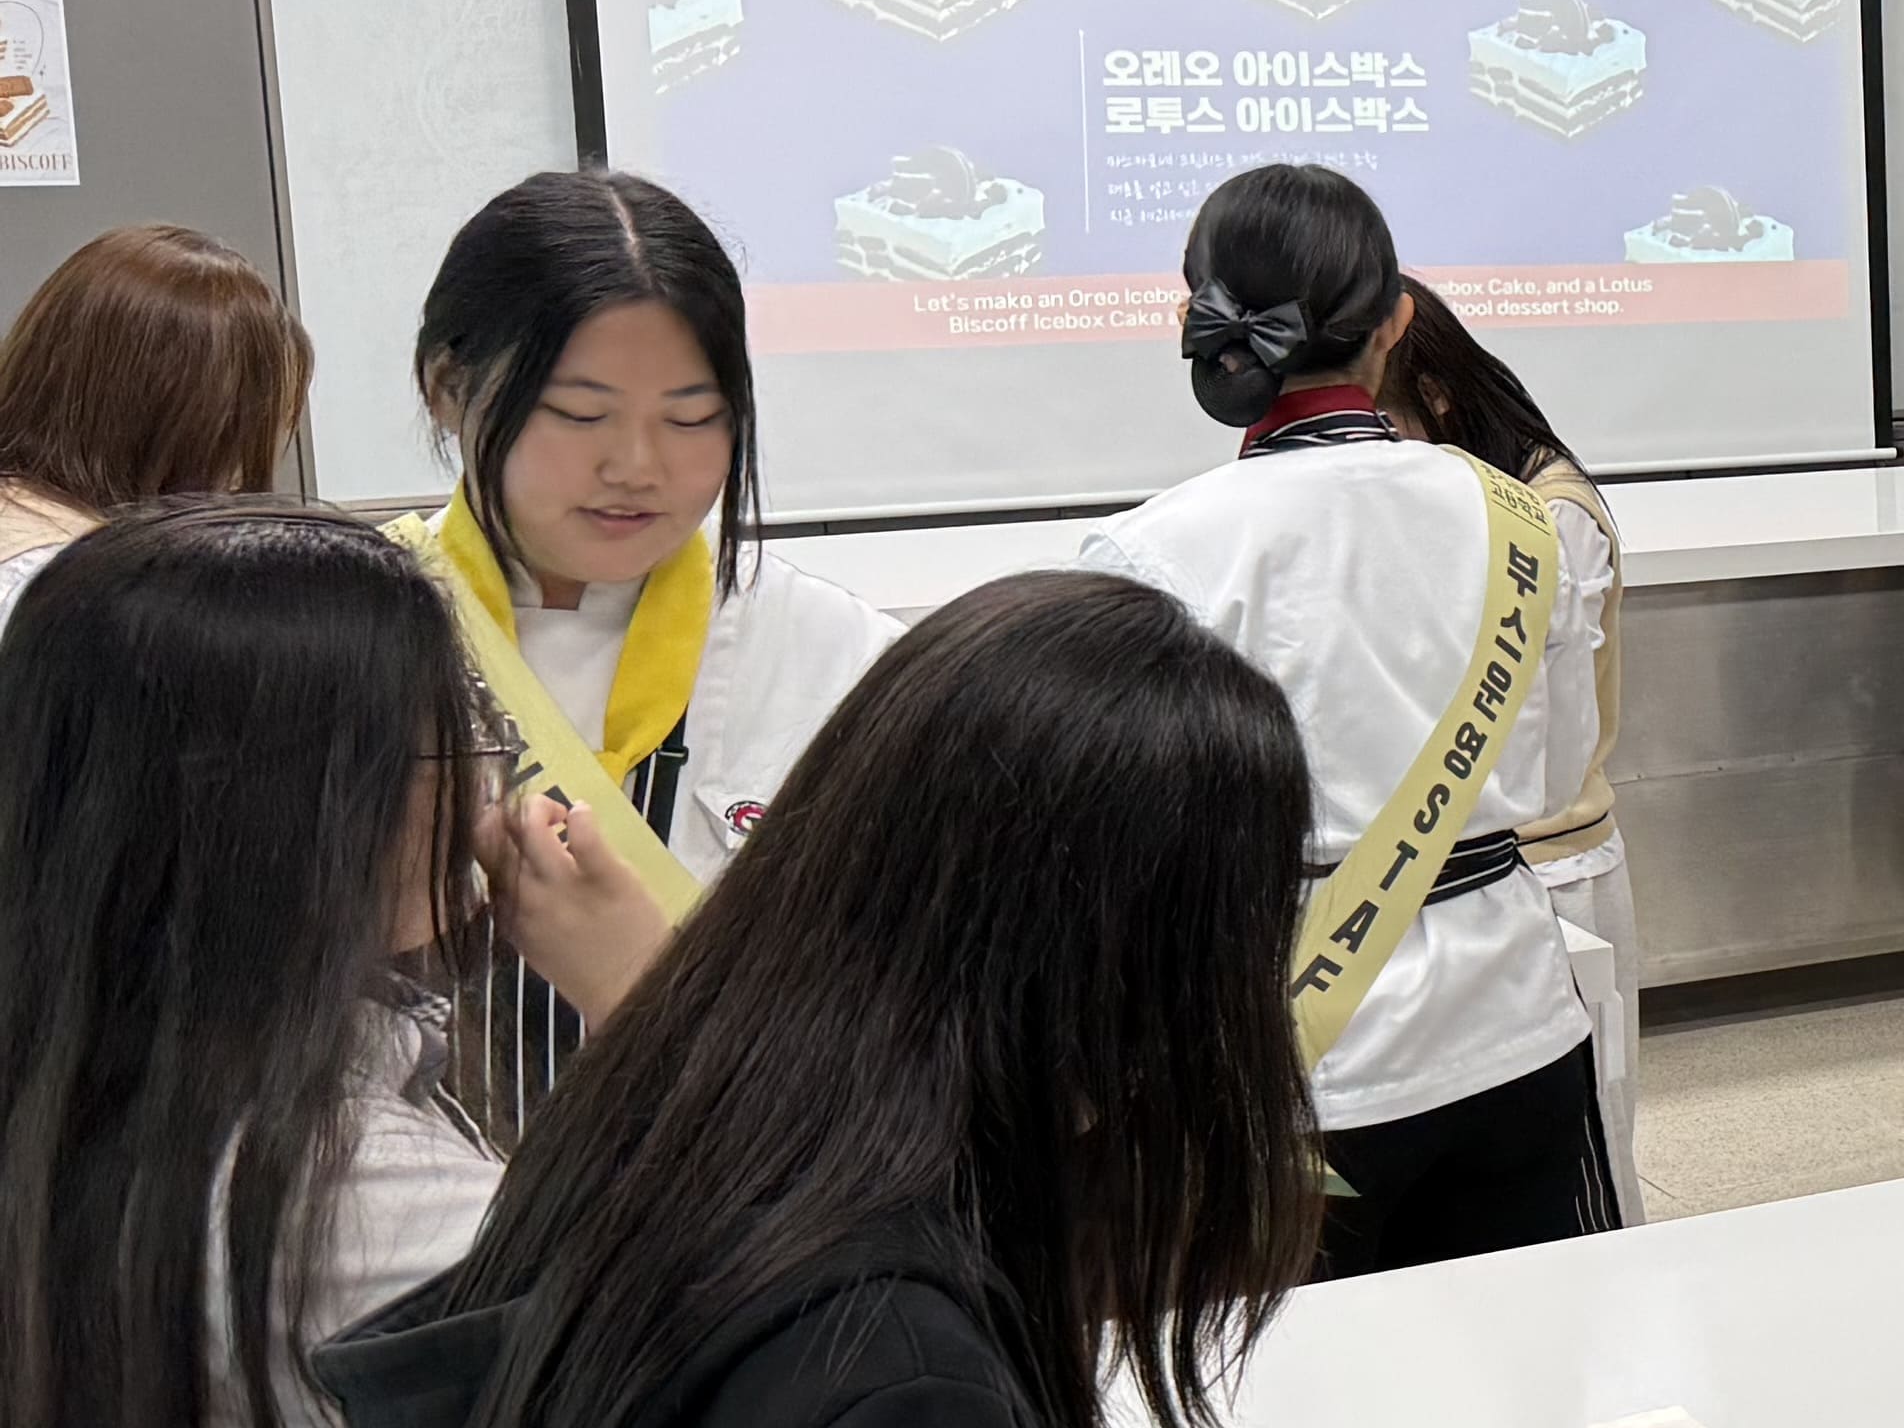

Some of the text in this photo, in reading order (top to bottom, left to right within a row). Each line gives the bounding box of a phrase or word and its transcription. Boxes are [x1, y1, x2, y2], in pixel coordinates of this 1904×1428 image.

[1103, 49, 1427, 88] 오레오 아이스박스
[1105, 97, 1429, 134] 로투스 아이스박스
[914, 286, 1182, 312] Let's make an Oreo Icebo
[1488, 279, 1541, 297] Cake,
[1546, 278, 1580, 293] and
[1584, 282, 1595, 293] a
[1600, 277, 1653, 293] Lotus
[1453, 297, 1624, 316] hool dessert shop.
[950, 313, 1029, 334] Biscoff
[1034, 311, 1105, 331] Icebox
[1110, 310, 1163, 328] Cake
